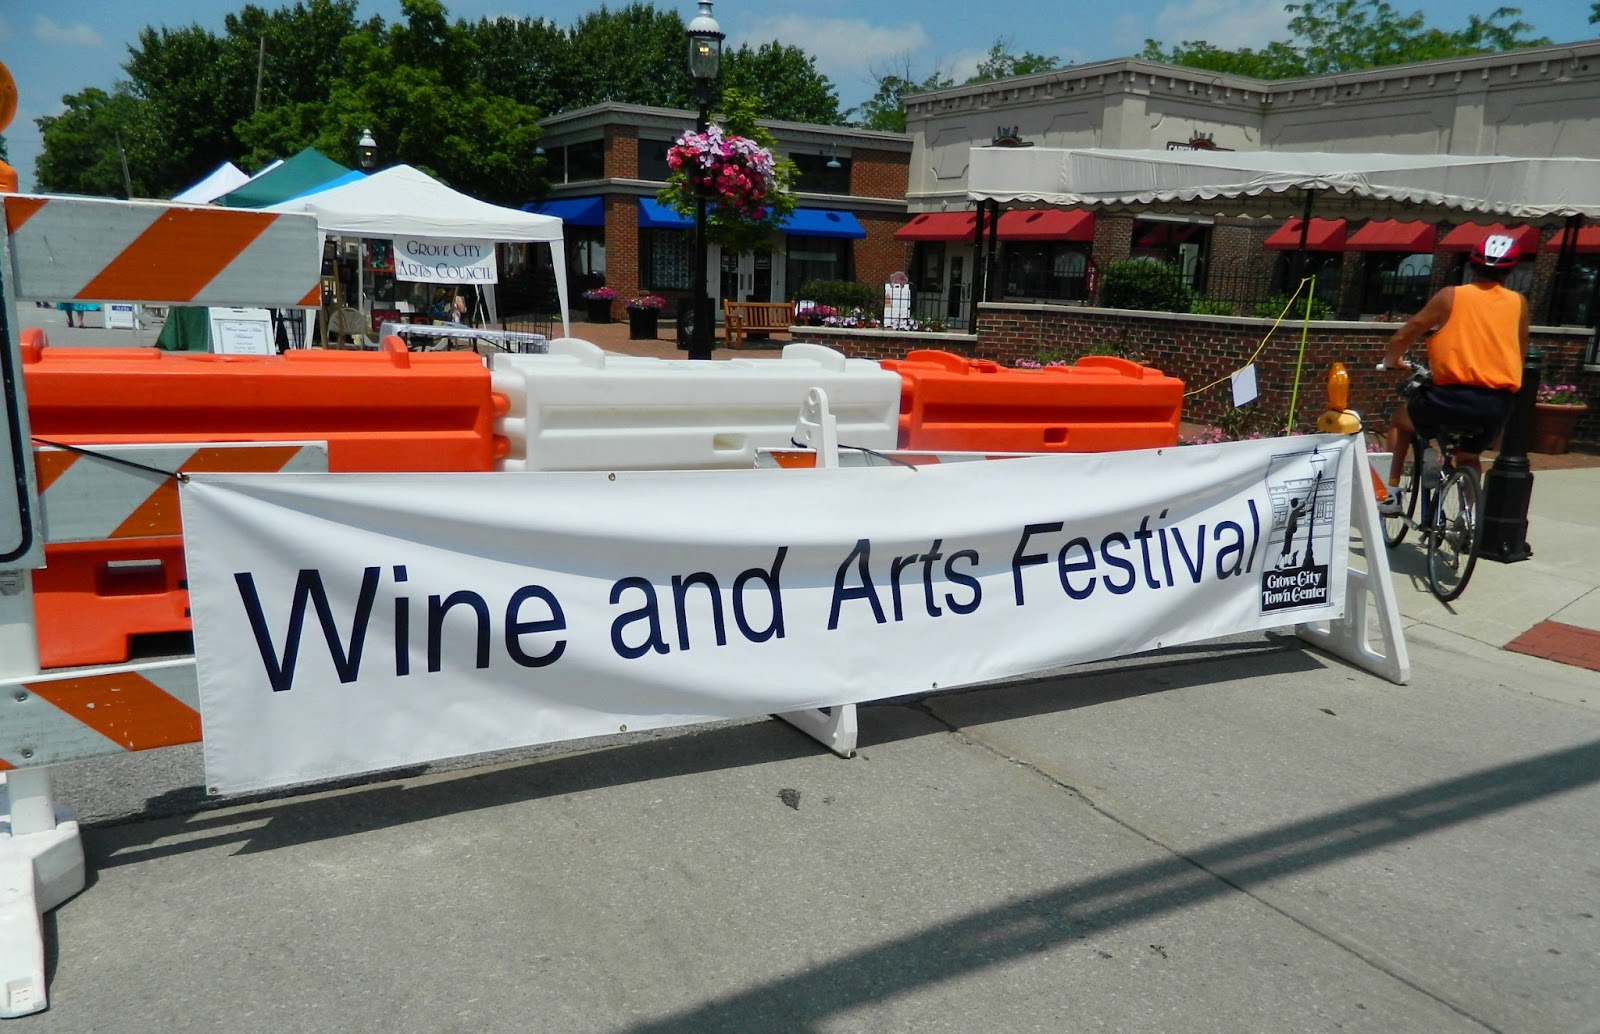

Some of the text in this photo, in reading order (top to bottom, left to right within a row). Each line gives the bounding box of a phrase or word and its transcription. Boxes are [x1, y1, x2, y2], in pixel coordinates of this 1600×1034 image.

[406, 240, 481, 257] GROVE CITY
[399, 260, 493, 279] ARTS COUNCIL
[1267, 570, 1322, 589] Grove City
[234, 500, 1260, 692] Wine and Arts Festival
[1263, 586, 1326, 605] Town Center
